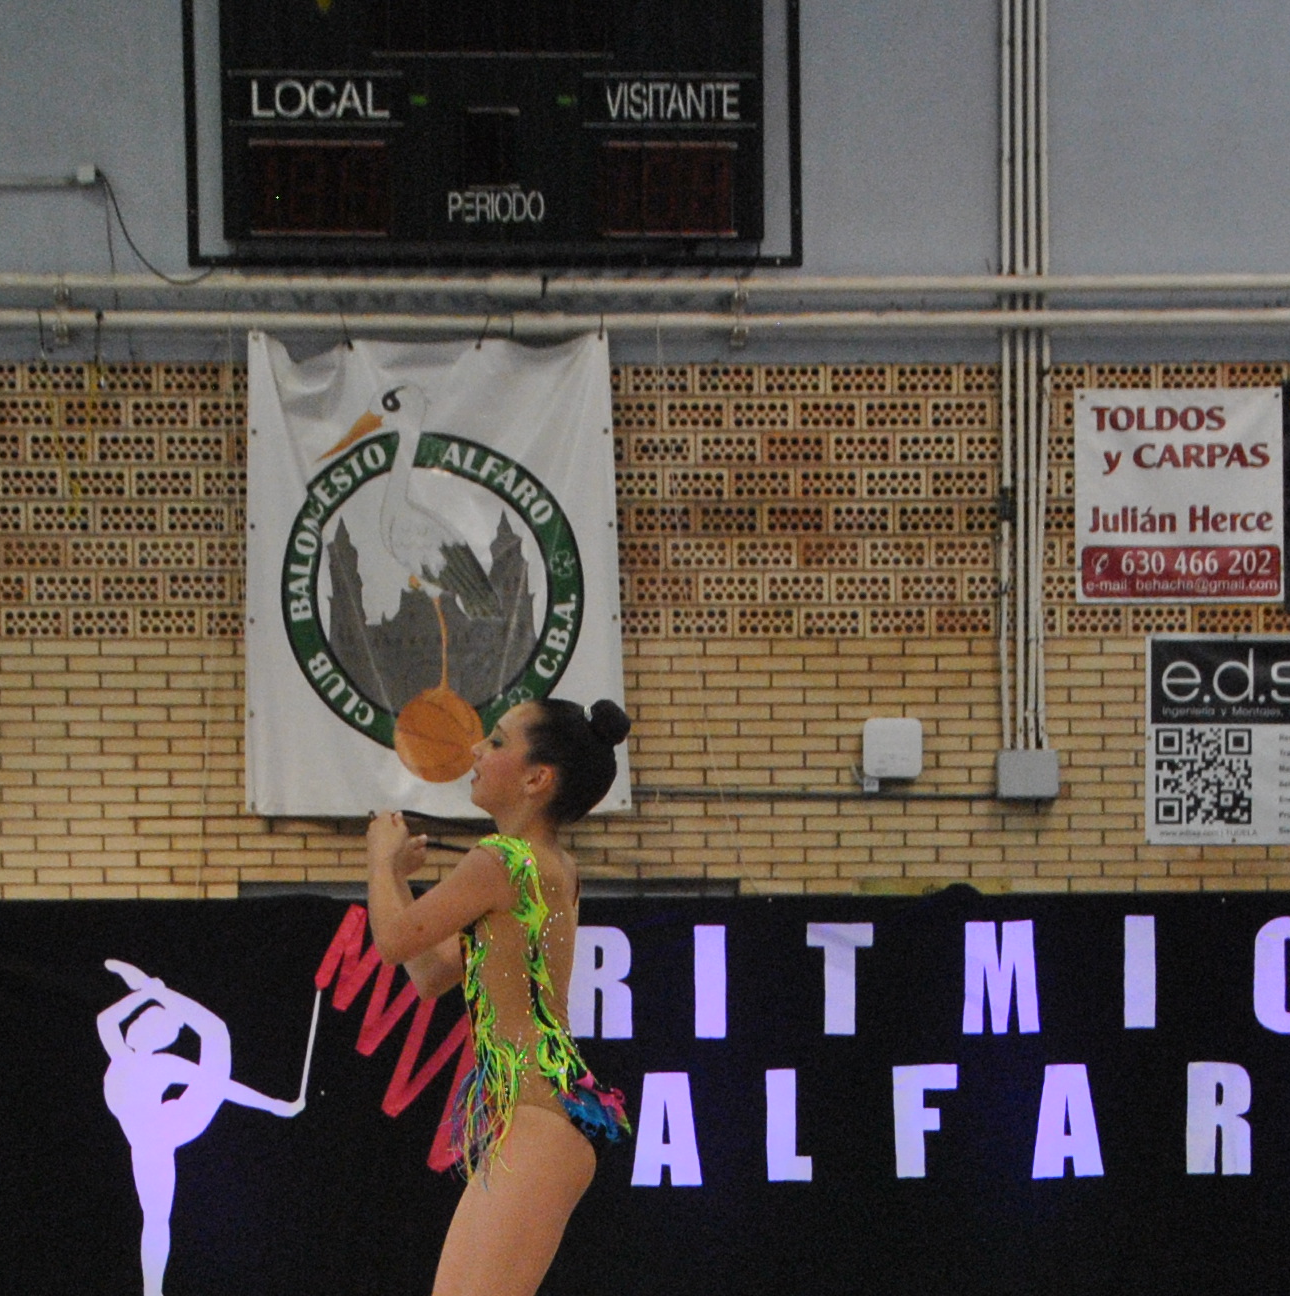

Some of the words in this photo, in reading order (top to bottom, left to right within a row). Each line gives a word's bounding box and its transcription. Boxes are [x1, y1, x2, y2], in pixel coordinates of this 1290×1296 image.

[249, 80, 391, 119] LOCAL
[607, 82, 741, 121] VISITANTE
[447, 191, 545, 222] PERIODO
[1090, 405, 1226, 432] TOLDOS
[1102, 451, 1122, 476] y
[1133, 442, 1271, 469] CARPAS
[441, 442, 554, 526] ALFARO
[1088, 505, 1177, 534] Julián
[1189, 504, 1274, 533] Herce
[1121, 550, 1165, 576] 630
[1174, 550, 1219, 576] 466
[1228, 549, 1272, 575] 202
[308, 651, 375, 727] CLUB
